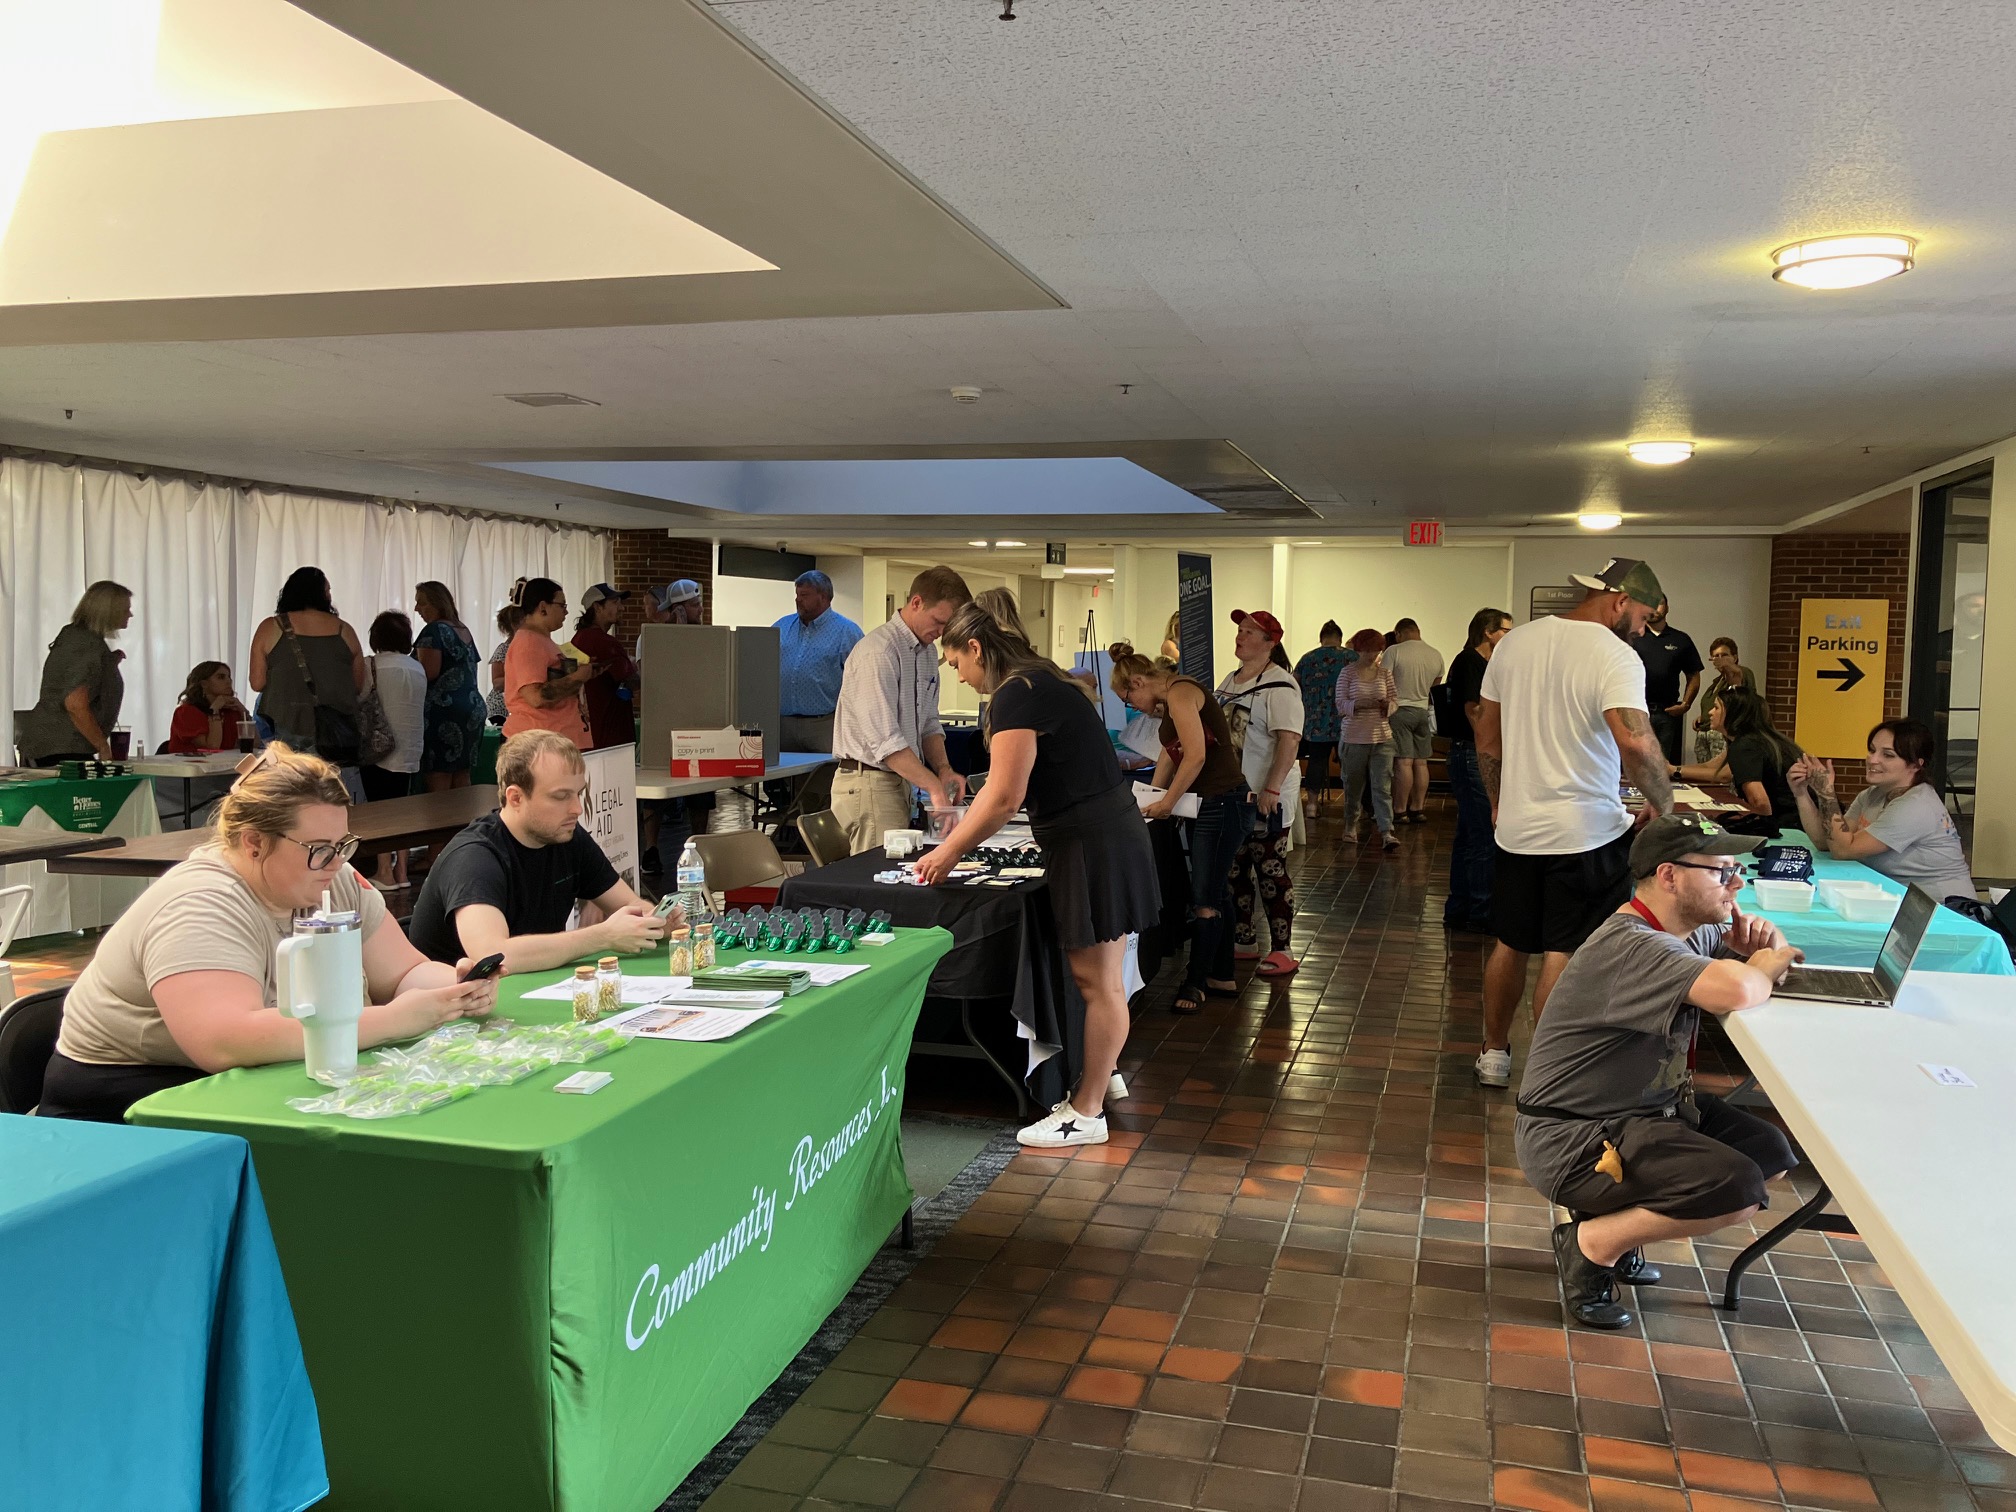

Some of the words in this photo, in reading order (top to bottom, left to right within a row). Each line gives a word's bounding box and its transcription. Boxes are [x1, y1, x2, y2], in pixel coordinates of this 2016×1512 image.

[1410, 521, 1440, 545] EXIT
[1180, 579, 1193, 598] ONE
[1825, 613, 1862, 629] Exit
[1807, 636, 1879, 655] Parking
[699, 747, 715, 755] print
[595, 787, 624, 814] LEGAL
[596, 813, 613, 838] AID
[625, 1185, 777, 1351] Community
[785, 1099, 873, 1211] Resources
